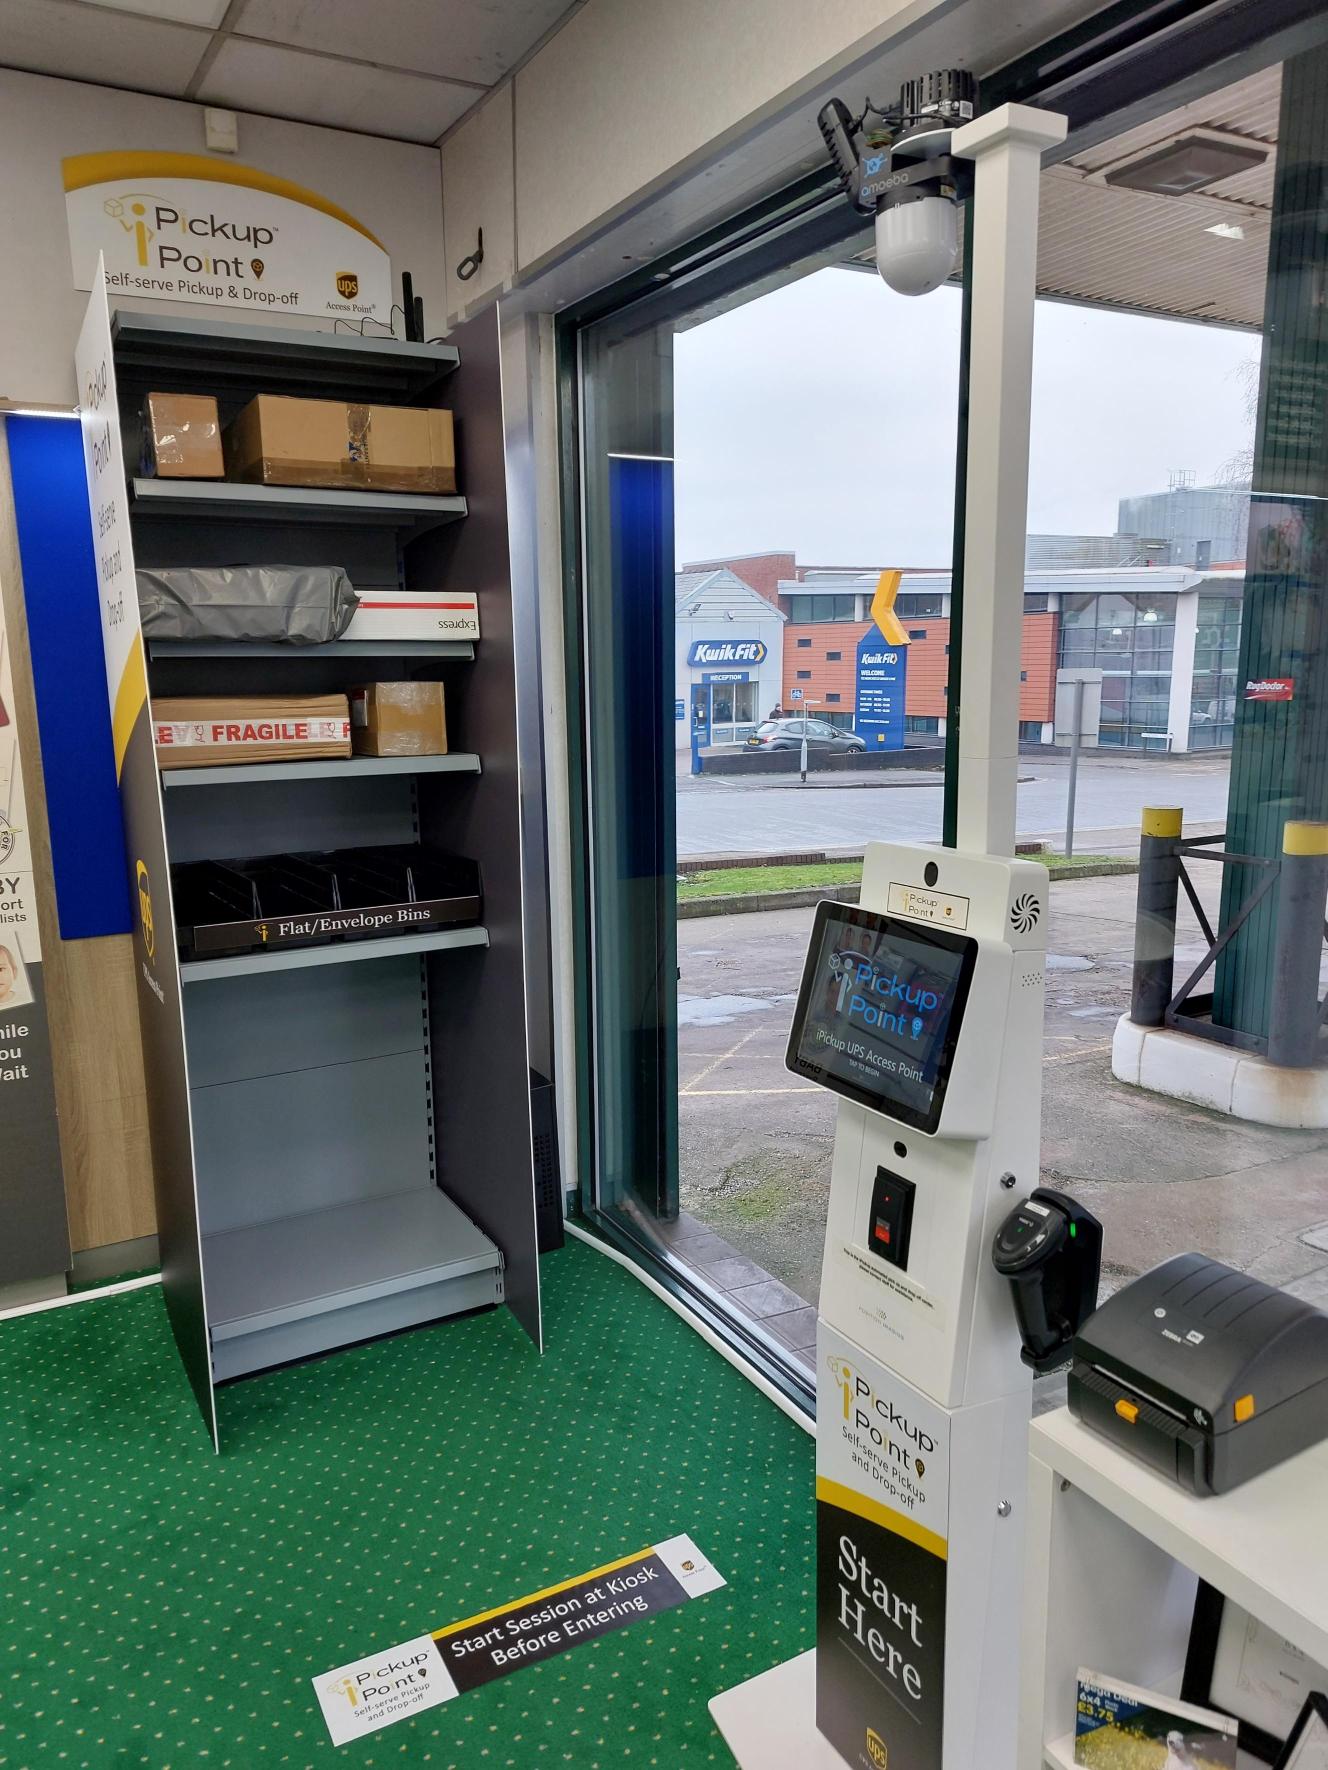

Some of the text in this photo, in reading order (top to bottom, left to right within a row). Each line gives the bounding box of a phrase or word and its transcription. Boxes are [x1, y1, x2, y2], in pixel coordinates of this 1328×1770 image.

[860, 173, 909, 197] amoeba
[158, 245, 245, 279] Point
[104, 270, 300, 305] Self-serve Pickup & Drop-off
[337, 279, 358, 297] ups
[326, 301, 351, 312] Access
[438, 618, 476, 631] Express
[211, 722, 308, 742] FRAGILE
[908, 905, 928, 917] Pont
[909, 893, 938, 907] Pckup
[278, 908, 431, 937] Flat/Envelope Bins
[855, 963, 938, 1013] Pickup
[848, 994, 907, 1036] Point
[816, 1028, 924, 1083] iPickup UPS Access Point
[849, 1059, 880, 1077] TAP TO BEGIN
[856, 1376, 934, 1453] Pickup
[855, 1408, 910, 1471] Point
[842, 1425, 926, 1503] Self-serve Pickup
[852, 1451, 915, 1511] and Drop-off
[838, 1535, 923, 1648] Start
[450, 1627, 505, 1658] Start
[505, 1599, 582, 1635] Session
[584, 1587, 606, 1605] at
[606, 1566, 660, 1595] Kiosk
[490, 1595, 649, 1666] Before Entering
[838, 1582, 922, 1700] Here
[356, 1652, 428, 1686] Pickup
[354, 1682, 430, 1718] Self-serve Pickup
[362, 1673, 416, 1702] Point
[368, 1692, 424, 1722] and Drop-off
[1078, 1701, 1114, 1722] £3.75
[868, 1736, 885, 1766] ups
